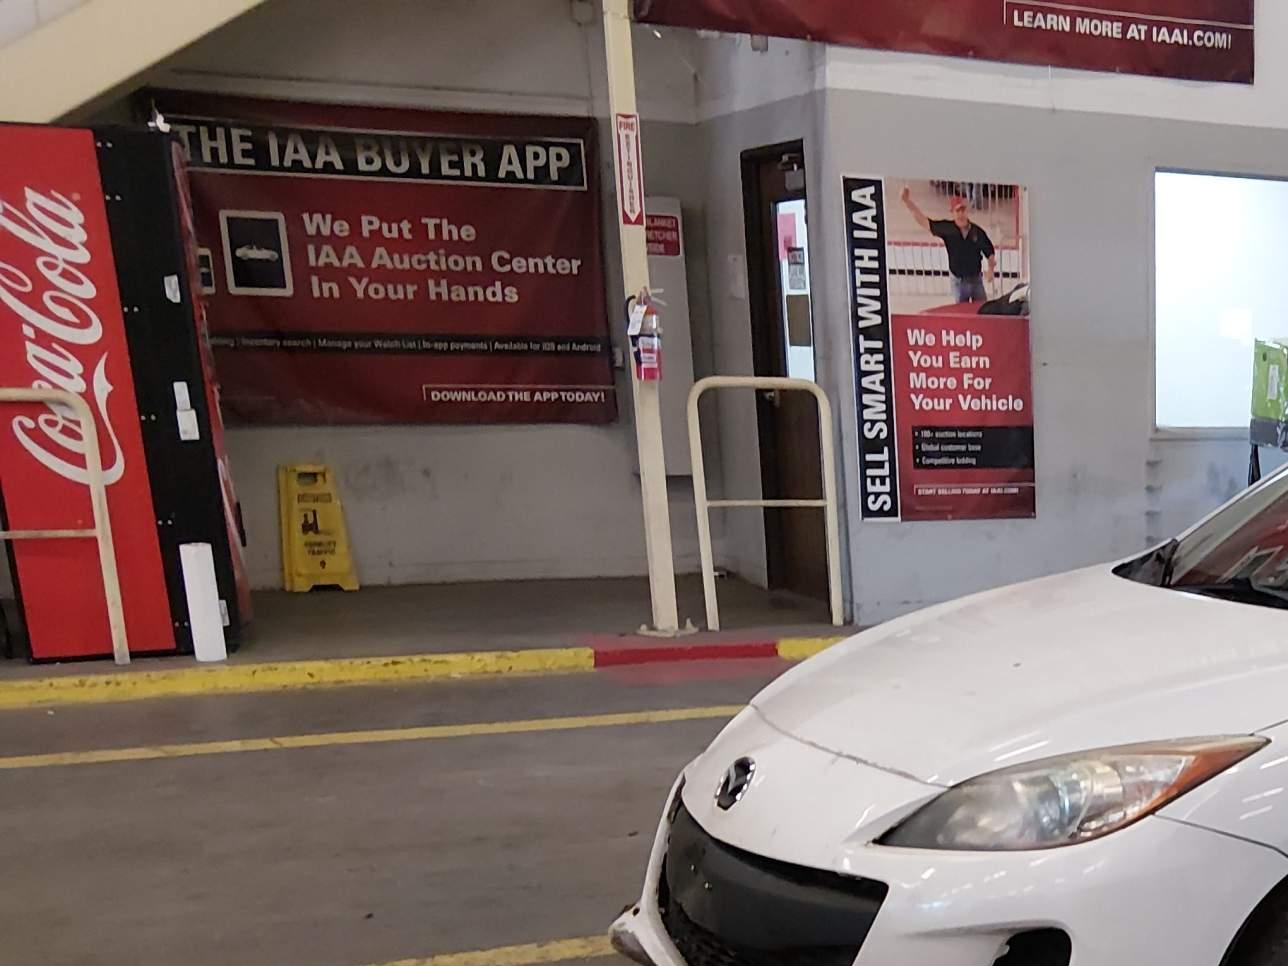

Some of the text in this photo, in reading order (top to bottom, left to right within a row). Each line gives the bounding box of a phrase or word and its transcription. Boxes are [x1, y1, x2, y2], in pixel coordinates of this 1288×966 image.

[1013, 9, 1232, 50] LEARN MORE AT IAAI.COM!
[171, 124, 570, 181] THE IAA BUYER APP
[302, 212, 476, 241] We Put The
[307, 244, 582, 275] IAA Auction Center
[311, 275, 519, 303] In Your Hands
[851, 185, 891, 512] SELL SMART WITH IAA
[907, 328, 983, 351] We Help
[908, 350, 990, 369] You Earn
[909, 372, 992, 390] More For
[431, 390, 605, 403] DOWNLOAD THE APP TODAY!
[910, 393, 1024, 411] Your Vehicle
